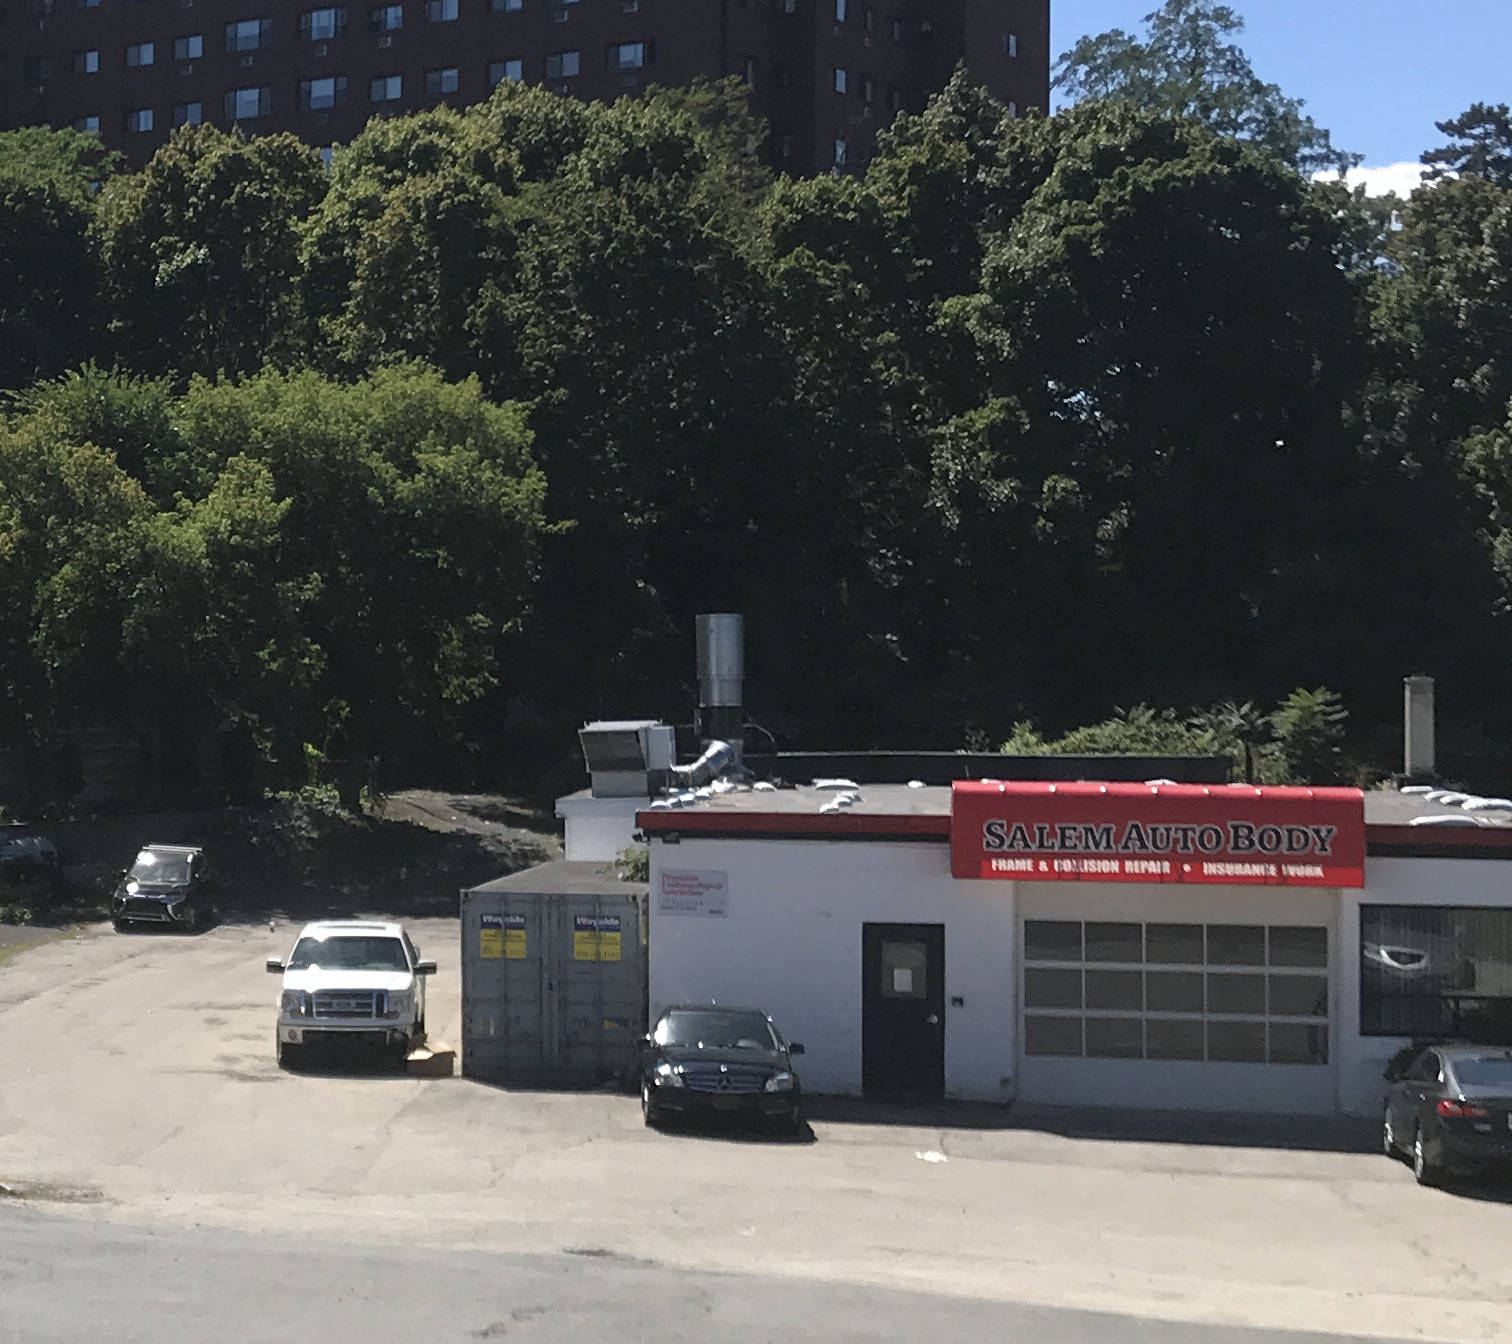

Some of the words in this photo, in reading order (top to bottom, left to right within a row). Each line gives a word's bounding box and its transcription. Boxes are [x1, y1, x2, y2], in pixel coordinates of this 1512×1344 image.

[984, 819, 1116, 853] SALEM
[1119, 820, 1225, 854] AUTO
[1227, 821, 1336, 855] BODY
[991, 858, 1034, 872] FRAME
[1038, 860, 1049, 873] &
[1124, 860, 1171, 875] REPAIR
